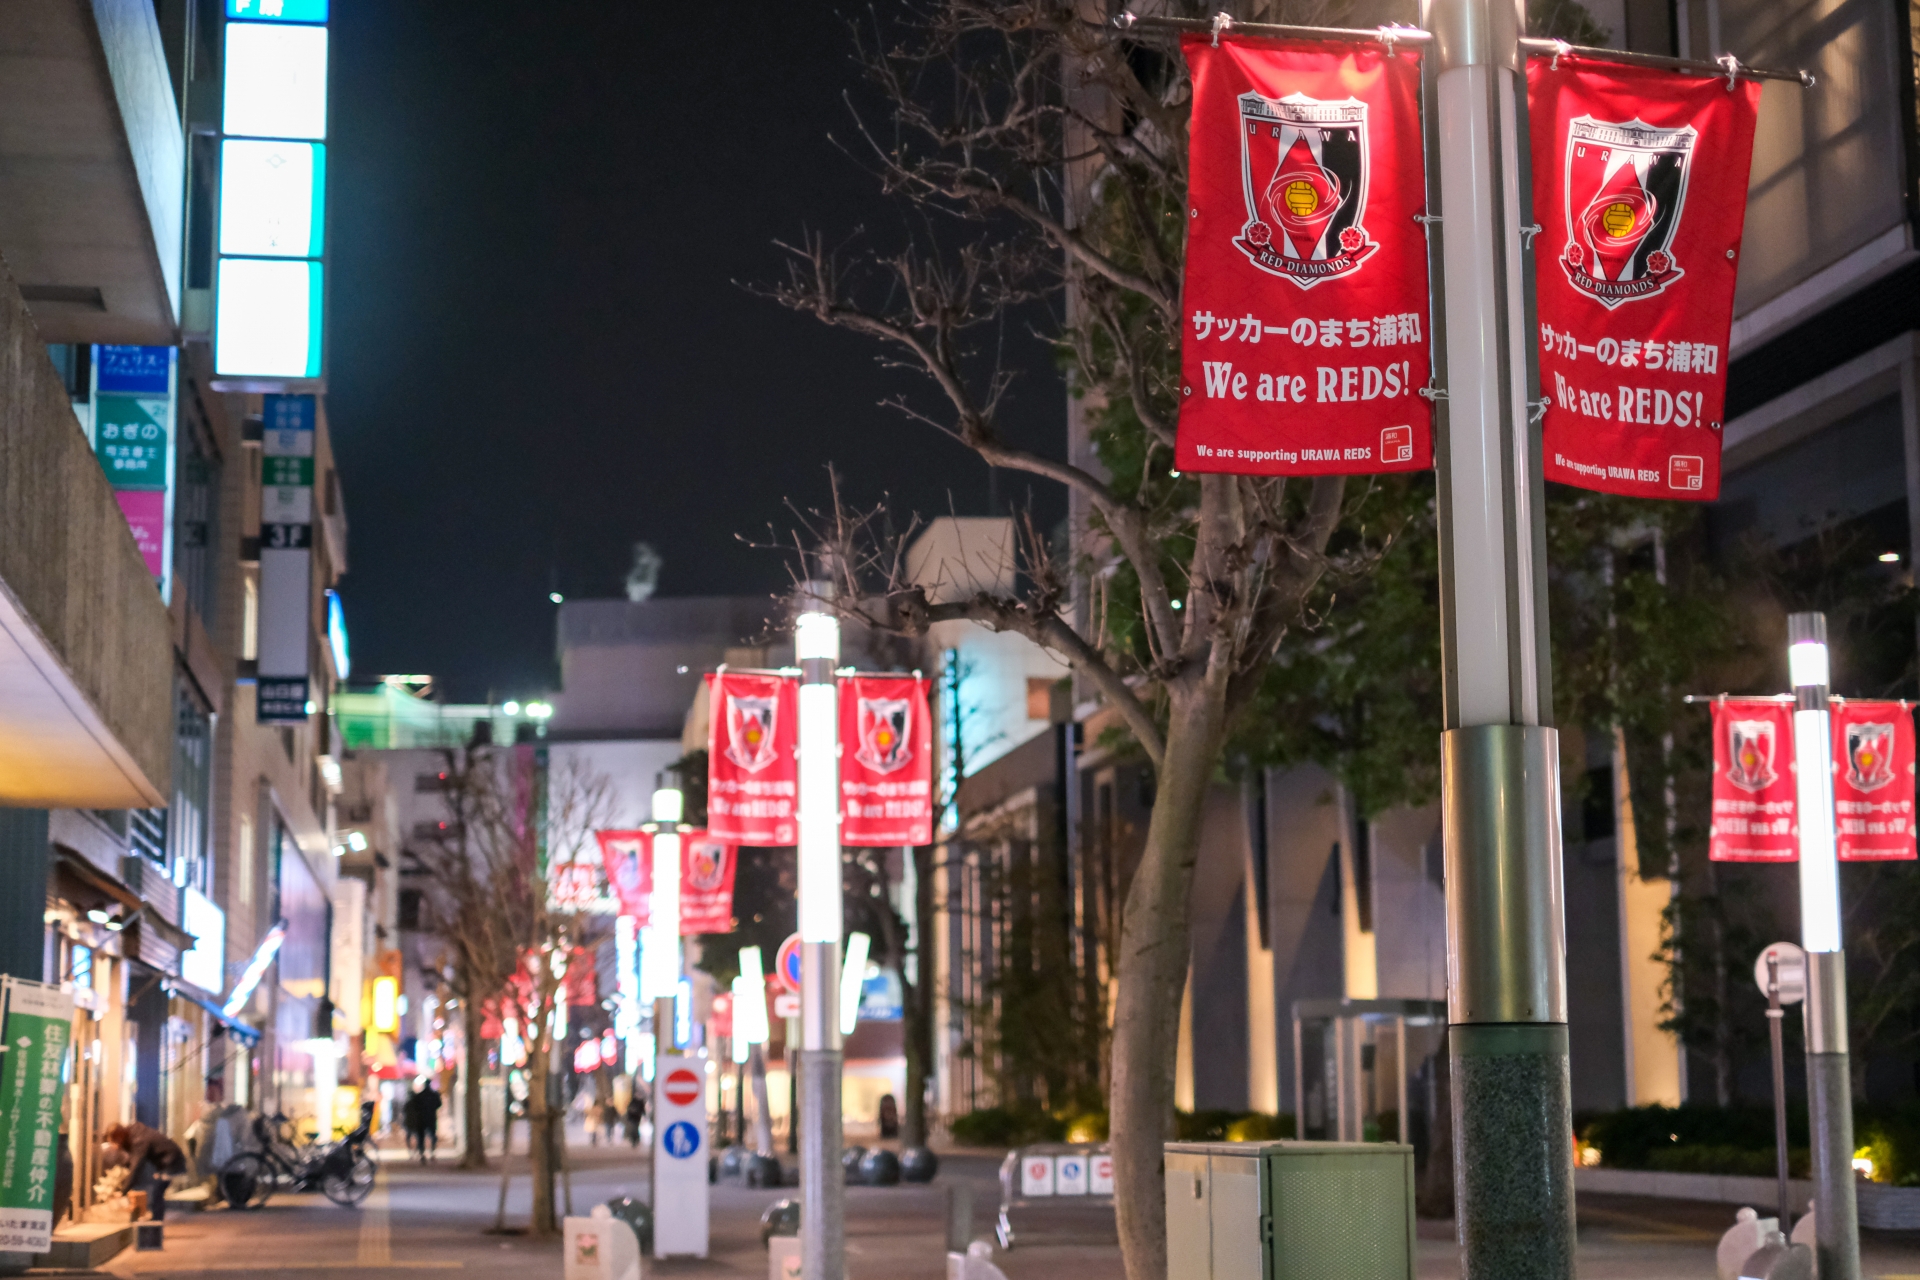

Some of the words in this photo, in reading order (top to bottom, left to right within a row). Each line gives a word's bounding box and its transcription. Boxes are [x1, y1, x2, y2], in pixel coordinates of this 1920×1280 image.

[1250, 124, 1357, 142] URAWA
[1577, 146, 1682, 168] URAWA
[1260, 252, 1283, 268] RED
[1286, 256, 1351, 274] DIAMONDS
[1575, 272, 1592, 288] RED
[1595, 278, 1655, 295] DIAMONDS
[1192, 310, 1422, 348] サッカーのまち浦和
[1541, 322, 1718, 374] サッカーのまち浦和
[1202, 361, 1248, 400] We
[1256, 372, 1306, 402] are
[1316, 360, 1410, 402] REDS!
[1554, 370, 1577, 412] We
[1580, 389, 1612, 420] are
[1618, 386, 1704, 428] REDS!
[102, 422, 158, 440] おぎの
[1196, 445, 1213, 457] We
[1216, 447, 1234, 458] are
[1238, 449, 1298, 464] supporting
[1301, 448, 1340, 461] URAWA
[1344, 447, 1372, 460] REDS
[1555, 453, 1566, 467] We
[1574, 460, 1606, 480] supporting
[1608, 466, 1635, 480] URAWA
[1638, 469, 1660, 482] REDS
